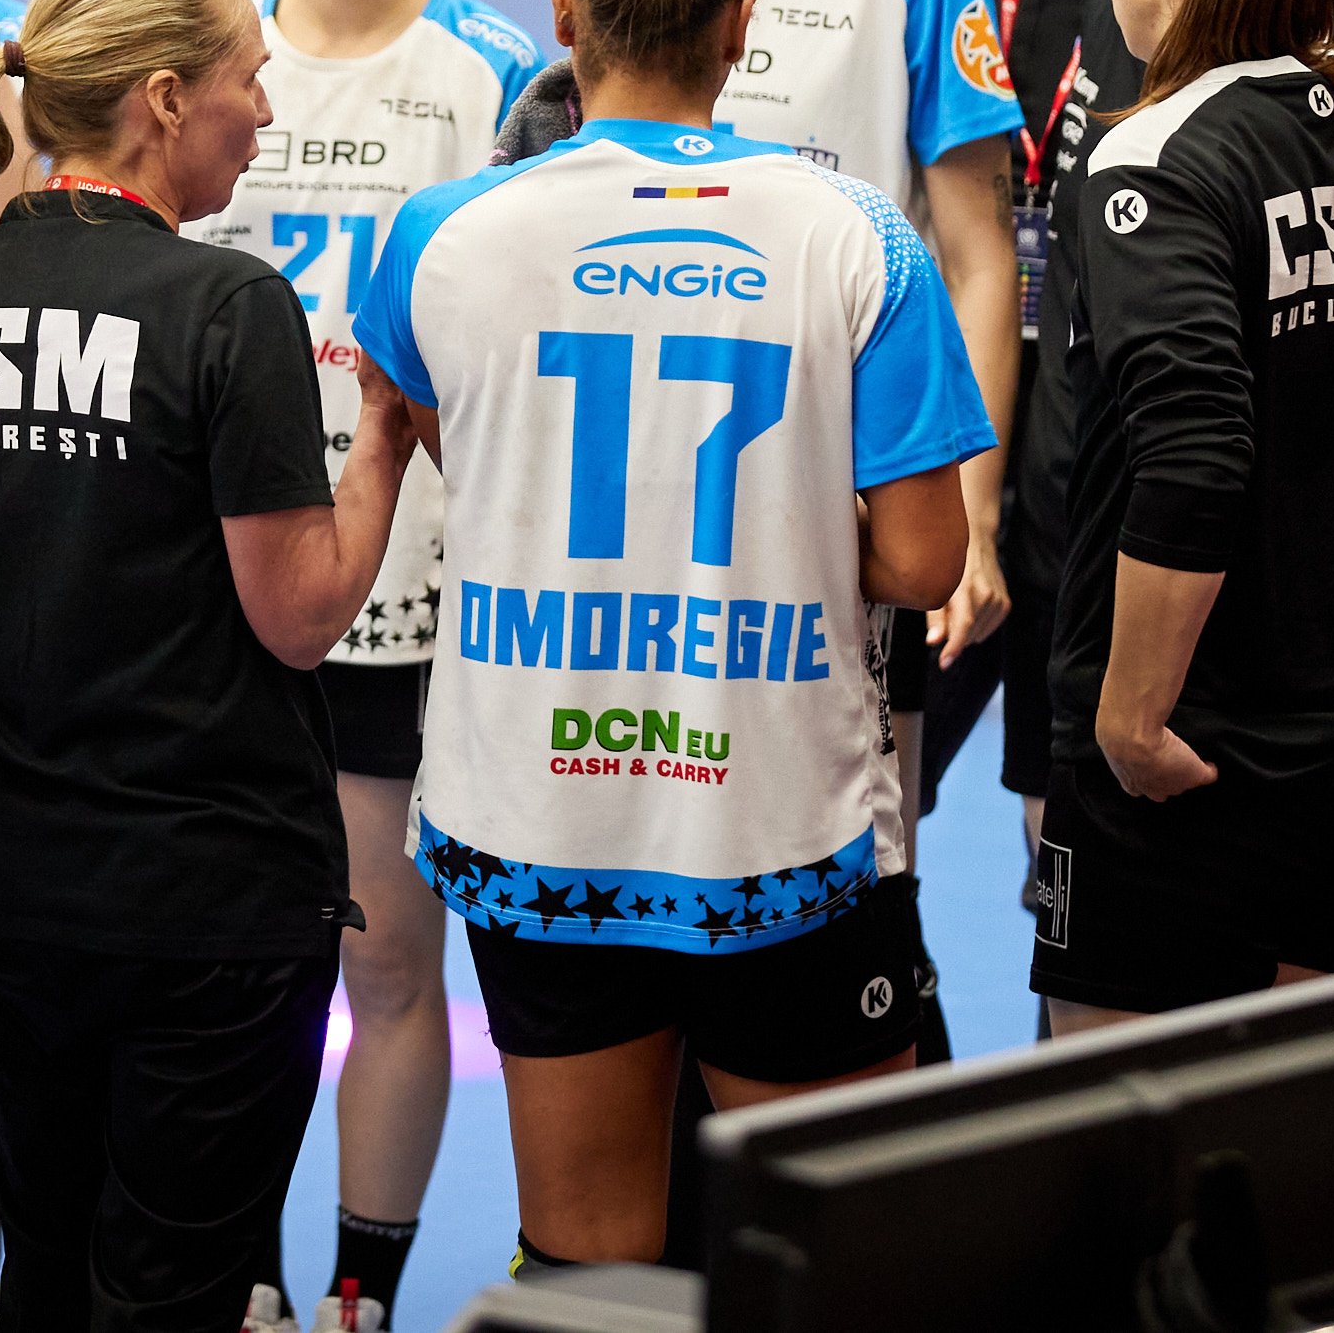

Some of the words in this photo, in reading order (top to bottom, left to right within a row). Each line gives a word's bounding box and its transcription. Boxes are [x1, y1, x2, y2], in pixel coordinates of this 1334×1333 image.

[772, 8, 854, 30] TESLA
[302, 140, 387, 166] BRD
[271, 212, 377, 315] 21
[538, 331, 792, 566] 17
[461, 580, 830, 682] OMOREGIE
[552, 708, 680, 755] DCN
[687, 729, 730, 762] EU
[550, 758, 620, 776] CASH
[630, 759, 648, 776] &
[657, 759, 729, 785] CARRY
